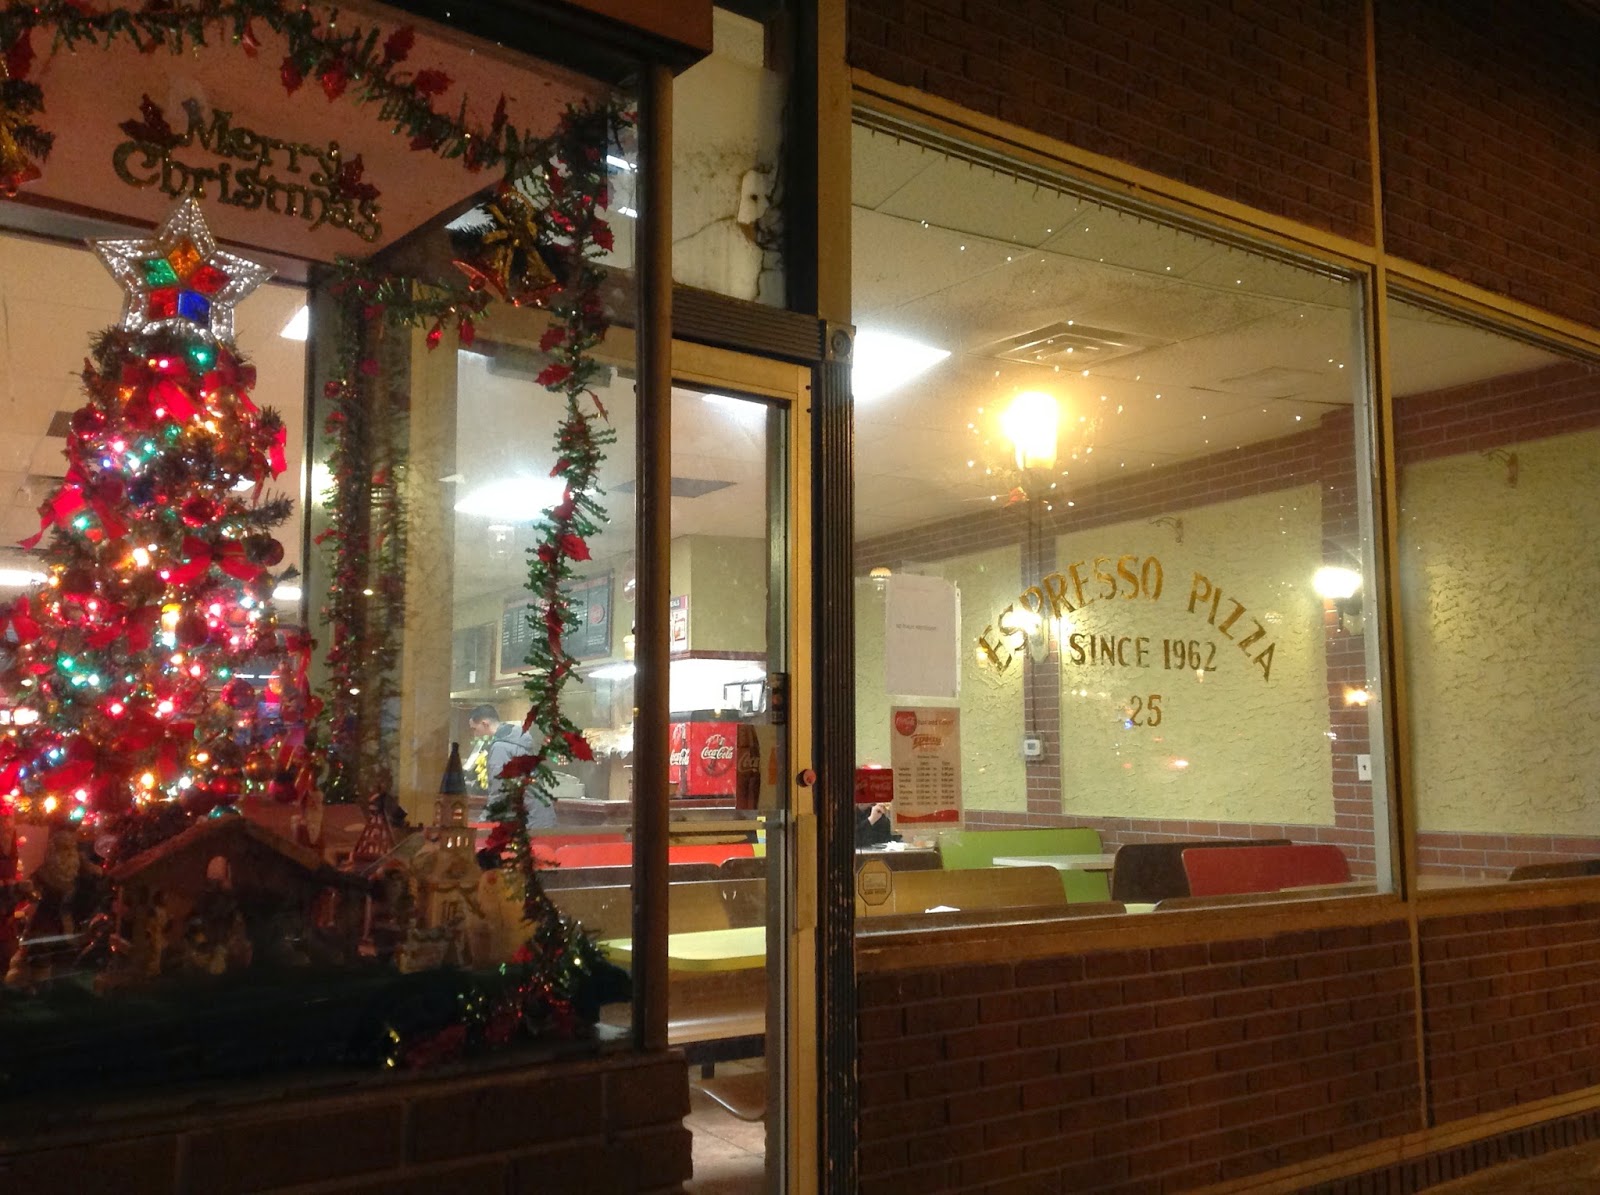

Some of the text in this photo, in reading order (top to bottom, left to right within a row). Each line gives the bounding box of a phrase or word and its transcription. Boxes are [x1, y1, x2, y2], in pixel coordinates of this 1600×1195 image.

[174, 98, 341, 186] Merry
[112, 141, 382, 243] Christmas
[979, 555, 1276, 682] ESPRESSO PIZZA
[1069, 633, 1217, 671] SINCE 1962
[1130, 694, 1162, 727] 25
